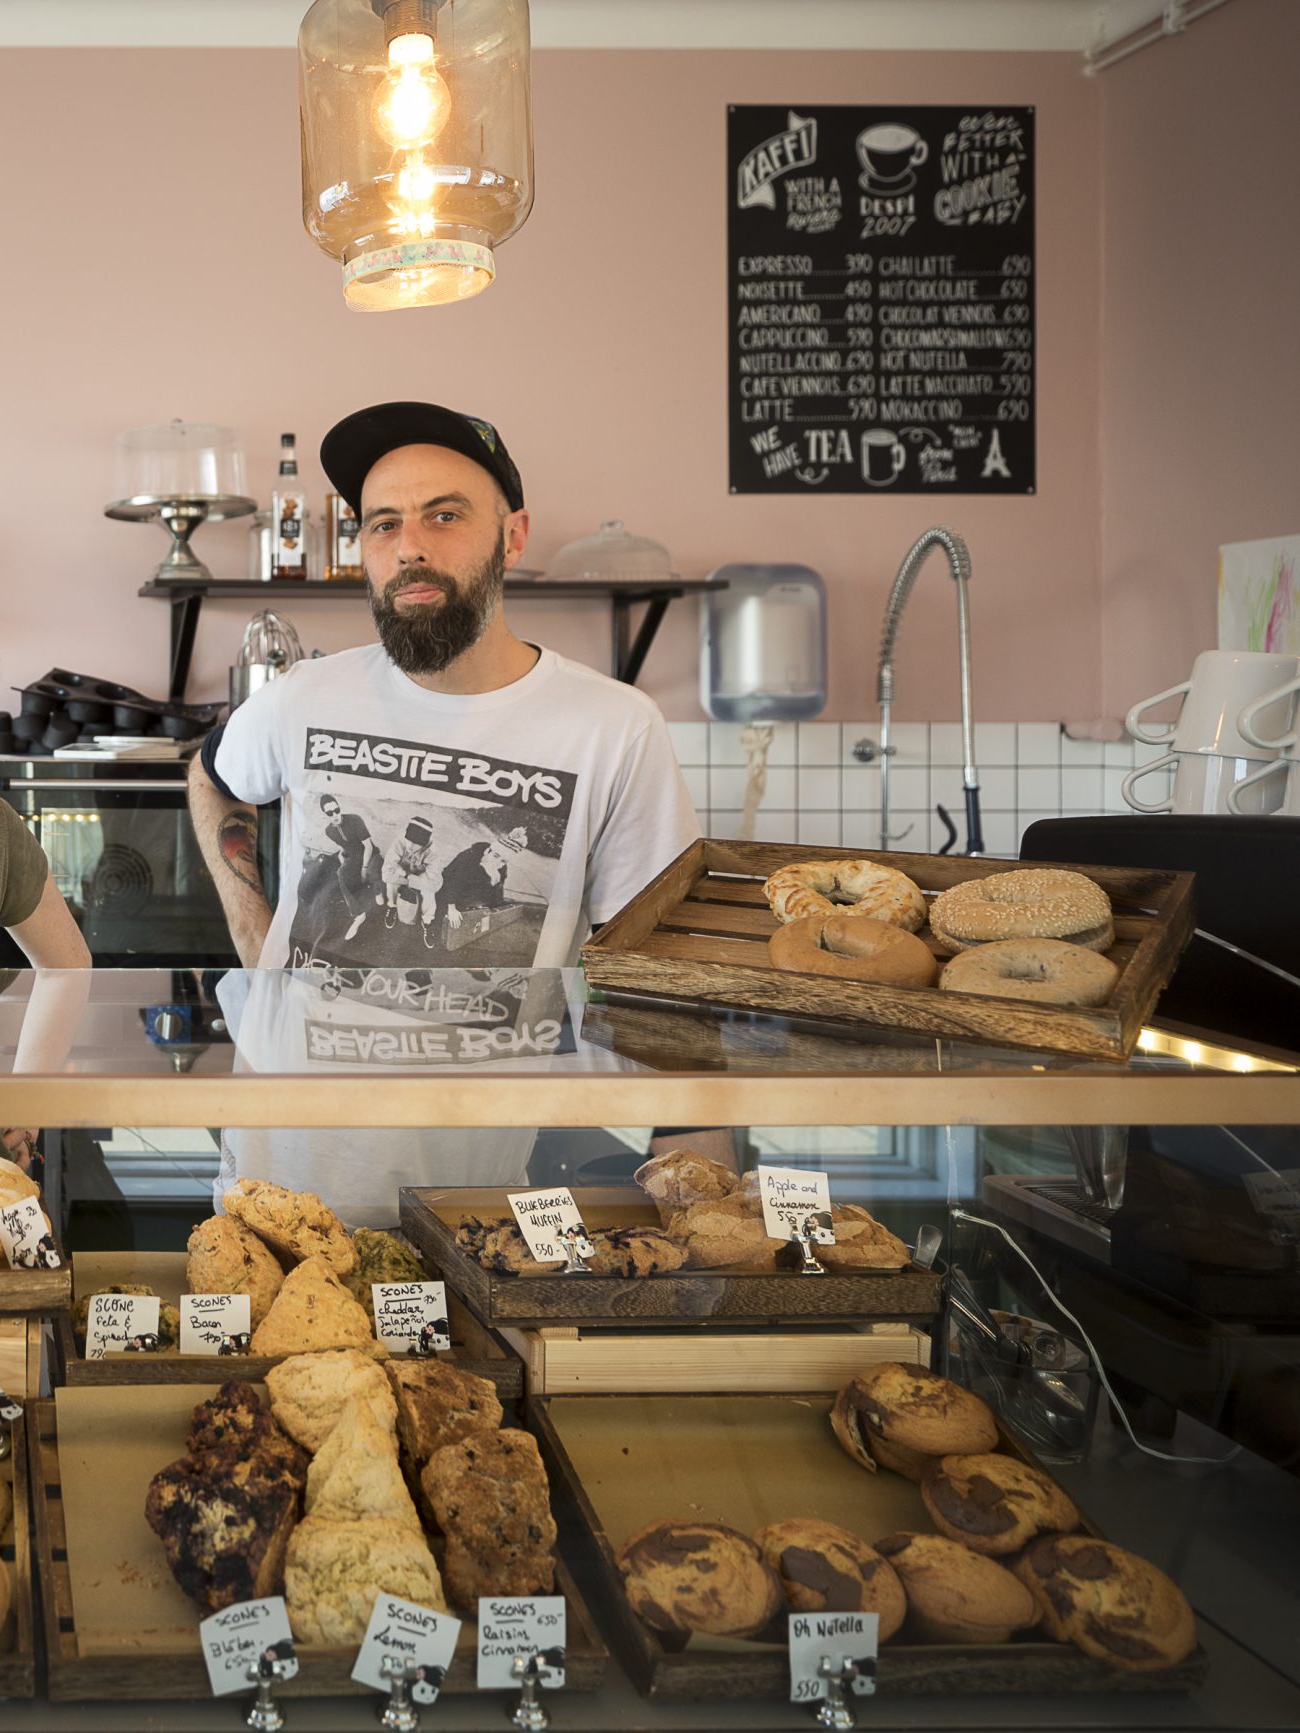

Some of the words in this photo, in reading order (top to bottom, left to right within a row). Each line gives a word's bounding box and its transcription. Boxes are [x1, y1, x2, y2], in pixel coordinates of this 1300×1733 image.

[741, 124, 812, 193] KAFFI
[933, 163, 1021, 224] COOKIE
[738, 254, 813, 276] EXPRESSO
[914, 255, 956, 277] LATTE
[738, 280, 805, 301] NOISETTE
[878, 280, 905, 301] HOT
[906, 279, 978, 301] CHOCOLATE
[738, 303, 821, 326] AMERICANO
[738, 326, 829, 350] CAPPUCCINO
[739, 350, 841, 375] NUTELLACCINO
[879, 349, 908, 372] HOT
[909, 351, 968, 372] NUTELLA
[880, 375, 924, 397] LATTE
[741, 399, 795, 422] LATTE
[880, 399, 963, 422] MOKACCINO
[750, 426, 782, 455] WE
[804, 428, 855, 463] TEA
[762, 441, 803, 479] HAVE
[308, 733, 452, 783] BEASTIE
[457, 756, 563, 809] BOYS
[357, 968, 434, 1006] YOUR
[423, 983, 510, 1022] HEAD
[767, 1175, 798, 1198] Apple
[801, 1182, 818, 1195] and
[530, 1211, 563, 1227] MUFFIN
[191, 1295, 232, 1308] SCONES
[380, 1284, 424, 1297] SCONES
[189, 1315, 222, 1329] Bacon
[214, 1603, 270, 1627] SCONES
[386, 1602, 438, 1633] SCONES
[489, 1602, 537, 1617] SCONES
